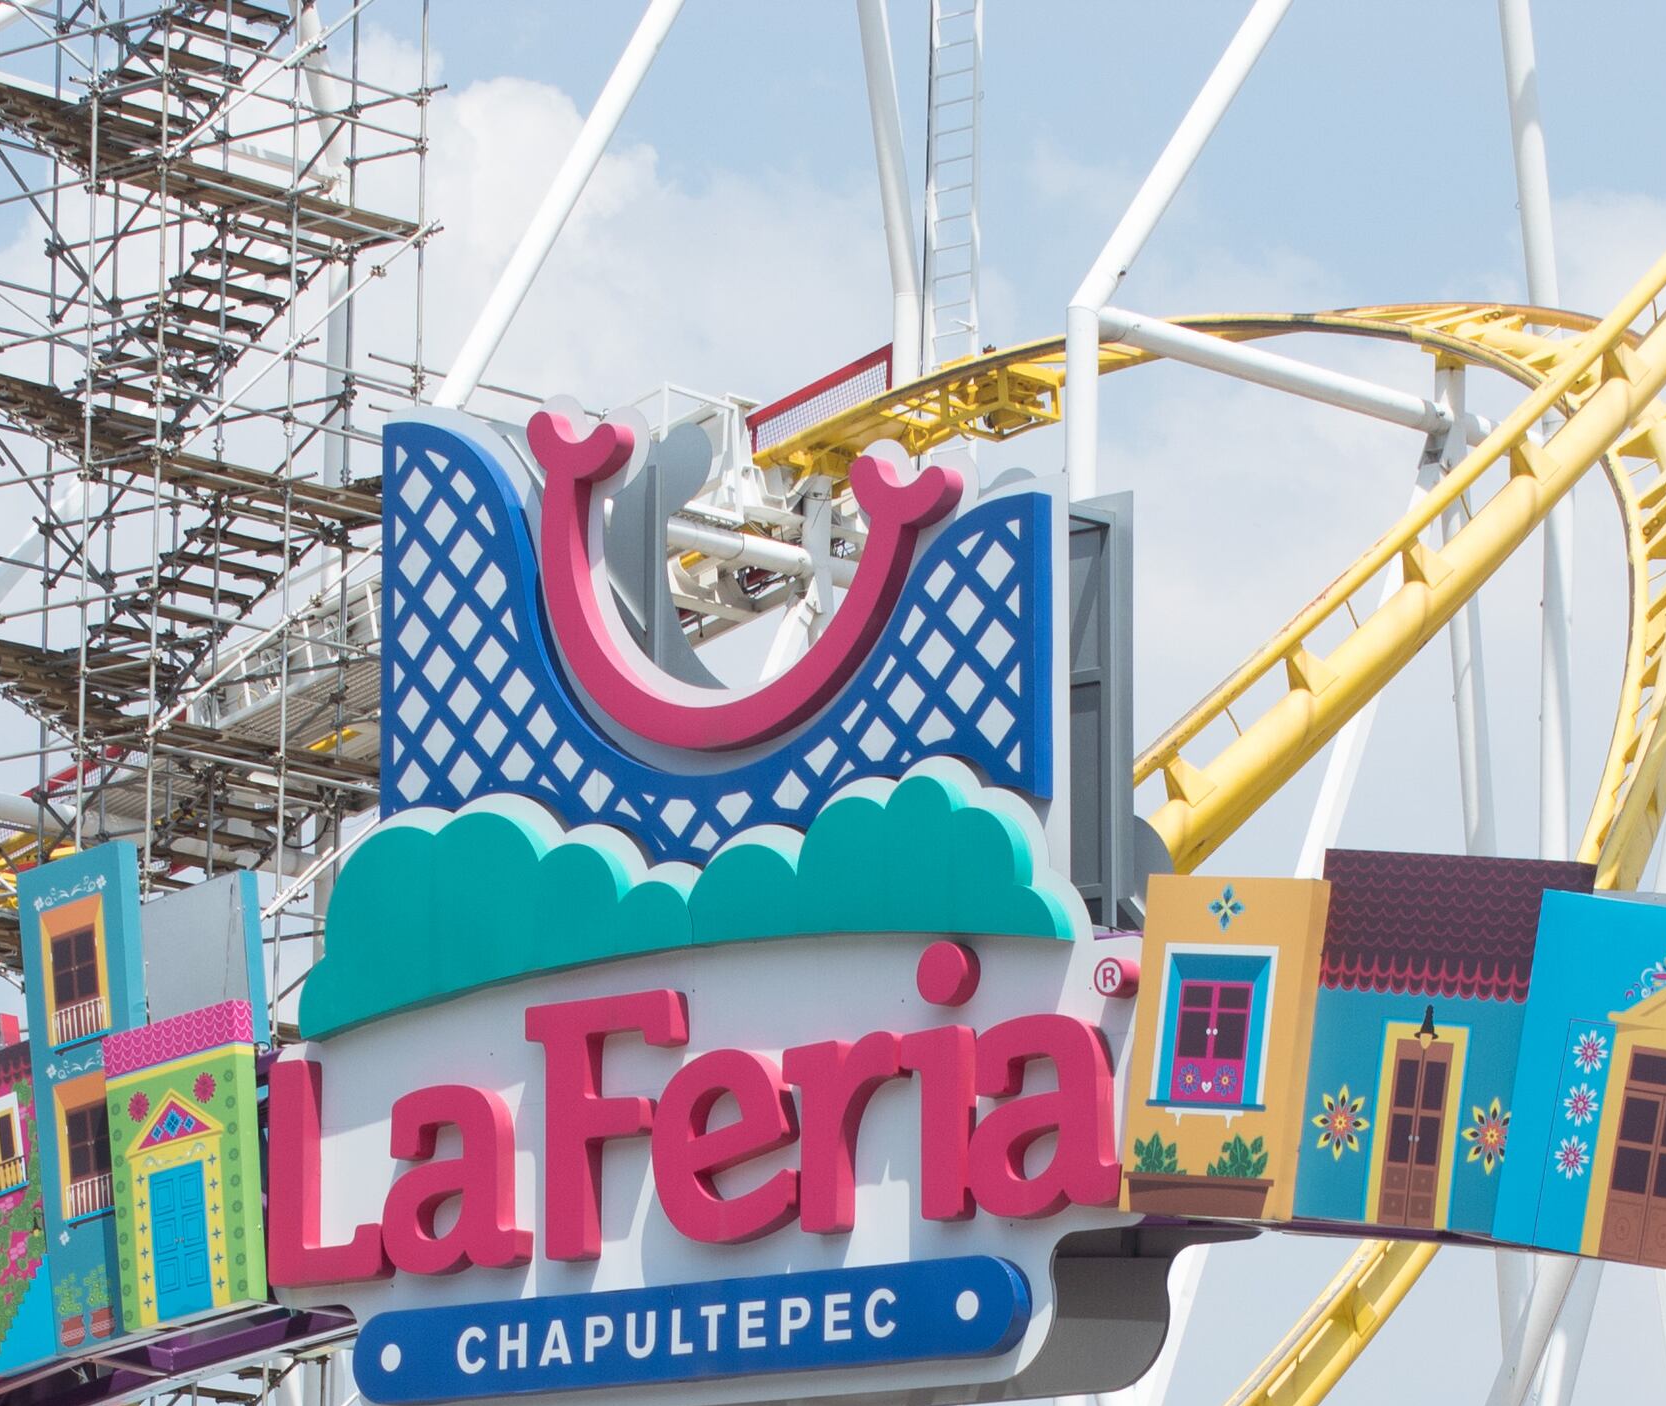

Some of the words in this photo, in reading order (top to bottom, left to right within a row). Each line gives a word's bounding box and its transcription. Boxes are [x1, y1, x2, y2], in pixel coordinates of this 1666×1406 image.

[266, 1060, 533, 1288] La
[525, 941, 1123, 1263] Feria
[455, 1287, 899, 1375] CHAPULTEPEC
